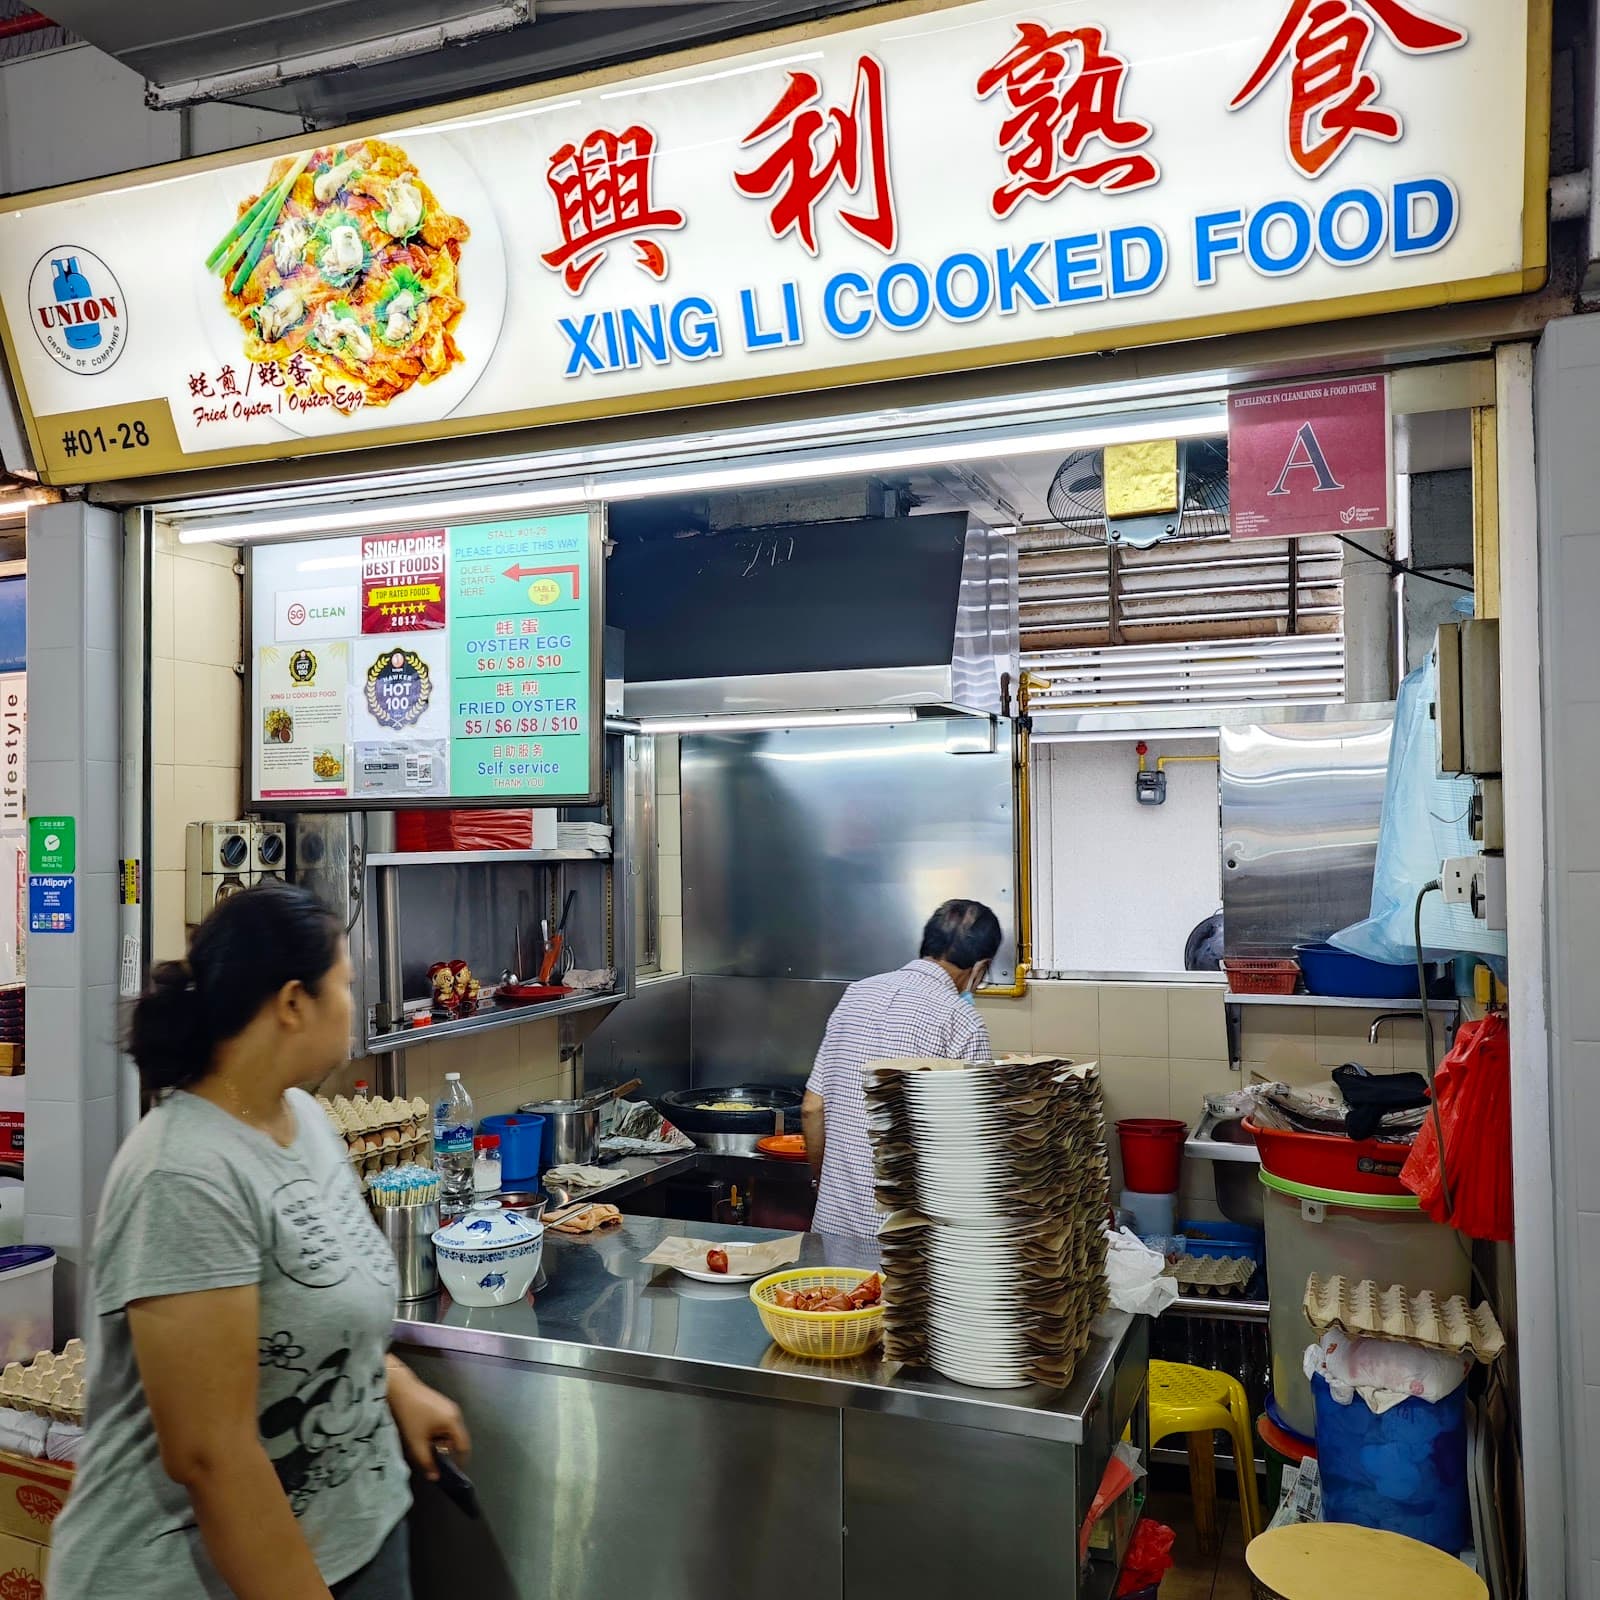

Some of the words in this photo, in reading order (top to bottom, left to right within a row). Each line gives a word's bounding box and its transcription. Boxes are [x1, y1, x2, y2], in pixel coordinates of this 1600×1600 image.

[558, 297, 719, 374] XING
[740, 282, 800, 347] LI
[824, 225, 1164, 334] COOKED
[1195, 178, 1454, 280] FOOD
[38, 297, 117, 328] UNION
[47, 335, 71, 361] GROUP
[76, 359, 87, 367] OF
[92, 325, 120, 366] COMPANIES
[1234, 394, 1272, 408] EXCELLENCE
[1273, 394, 1280, 403] IN
[1281, 391, 1322, 402] CLEANLINESS
[1323, 388, 1329, 397] &
[1330, 386, 1348, 396] FOOD
[1349, 382, 1377, 395] HYGIENE
[193, 405, 227, 427] Fried
[233, 401, 273, 421] Oyster
[288, 393, 330, 413] Oyster
[336, 385, 363, 408] Egg
[62, 420, 149, 457] #01-28
[1267, 421, 1344, 496] A
[488, 530, 515, 540] STALL
[364, 536, 442, 559] SINGAPORE
[455, 546, 494, 558] PLEASE
[495, 542, 529, 555] QUEUE
[532, 540, 554, 552] THIS
[557, 538, 579, 549] WAY
[366, 560, 395, 577] BEST
[400, 556, 439, 574] FOODS
[460, 565, 491, 575] QUEUE
[386, 575, 419, 587] ENJOY
[460, 575, 496, 586] STARTS
[376, 591, 387, 600] TOP
[388, 589, 408, 598] RATED
[410, 587, 430, 596] FOODS
[460, 587, 485, 597] HERE
[533, 585, 556, 593] TABLE
[290, 609, 305, 619] SG
[308, 607, 346, 618] CLEAN
[391, 615, 417, 627] 2017
[466, 637, 530, 653] OYSTER
[536, 635, 571, 649] EGG
[293, 691, 317, 699] COOKED
[383, 683, 412, 697] HOT
[386, 697, 409, 710] 100
[460, 701, 505, 715] FRIED
[512, 698, 577, 713] OYSTER
[4, 694, 21, 818] lifestyle
[478, 761, 503, 775] Self
[509, 761, 559, 775] service
[494, 778, 522, 788] THANK
[527, 777, 544, 787] YOU
